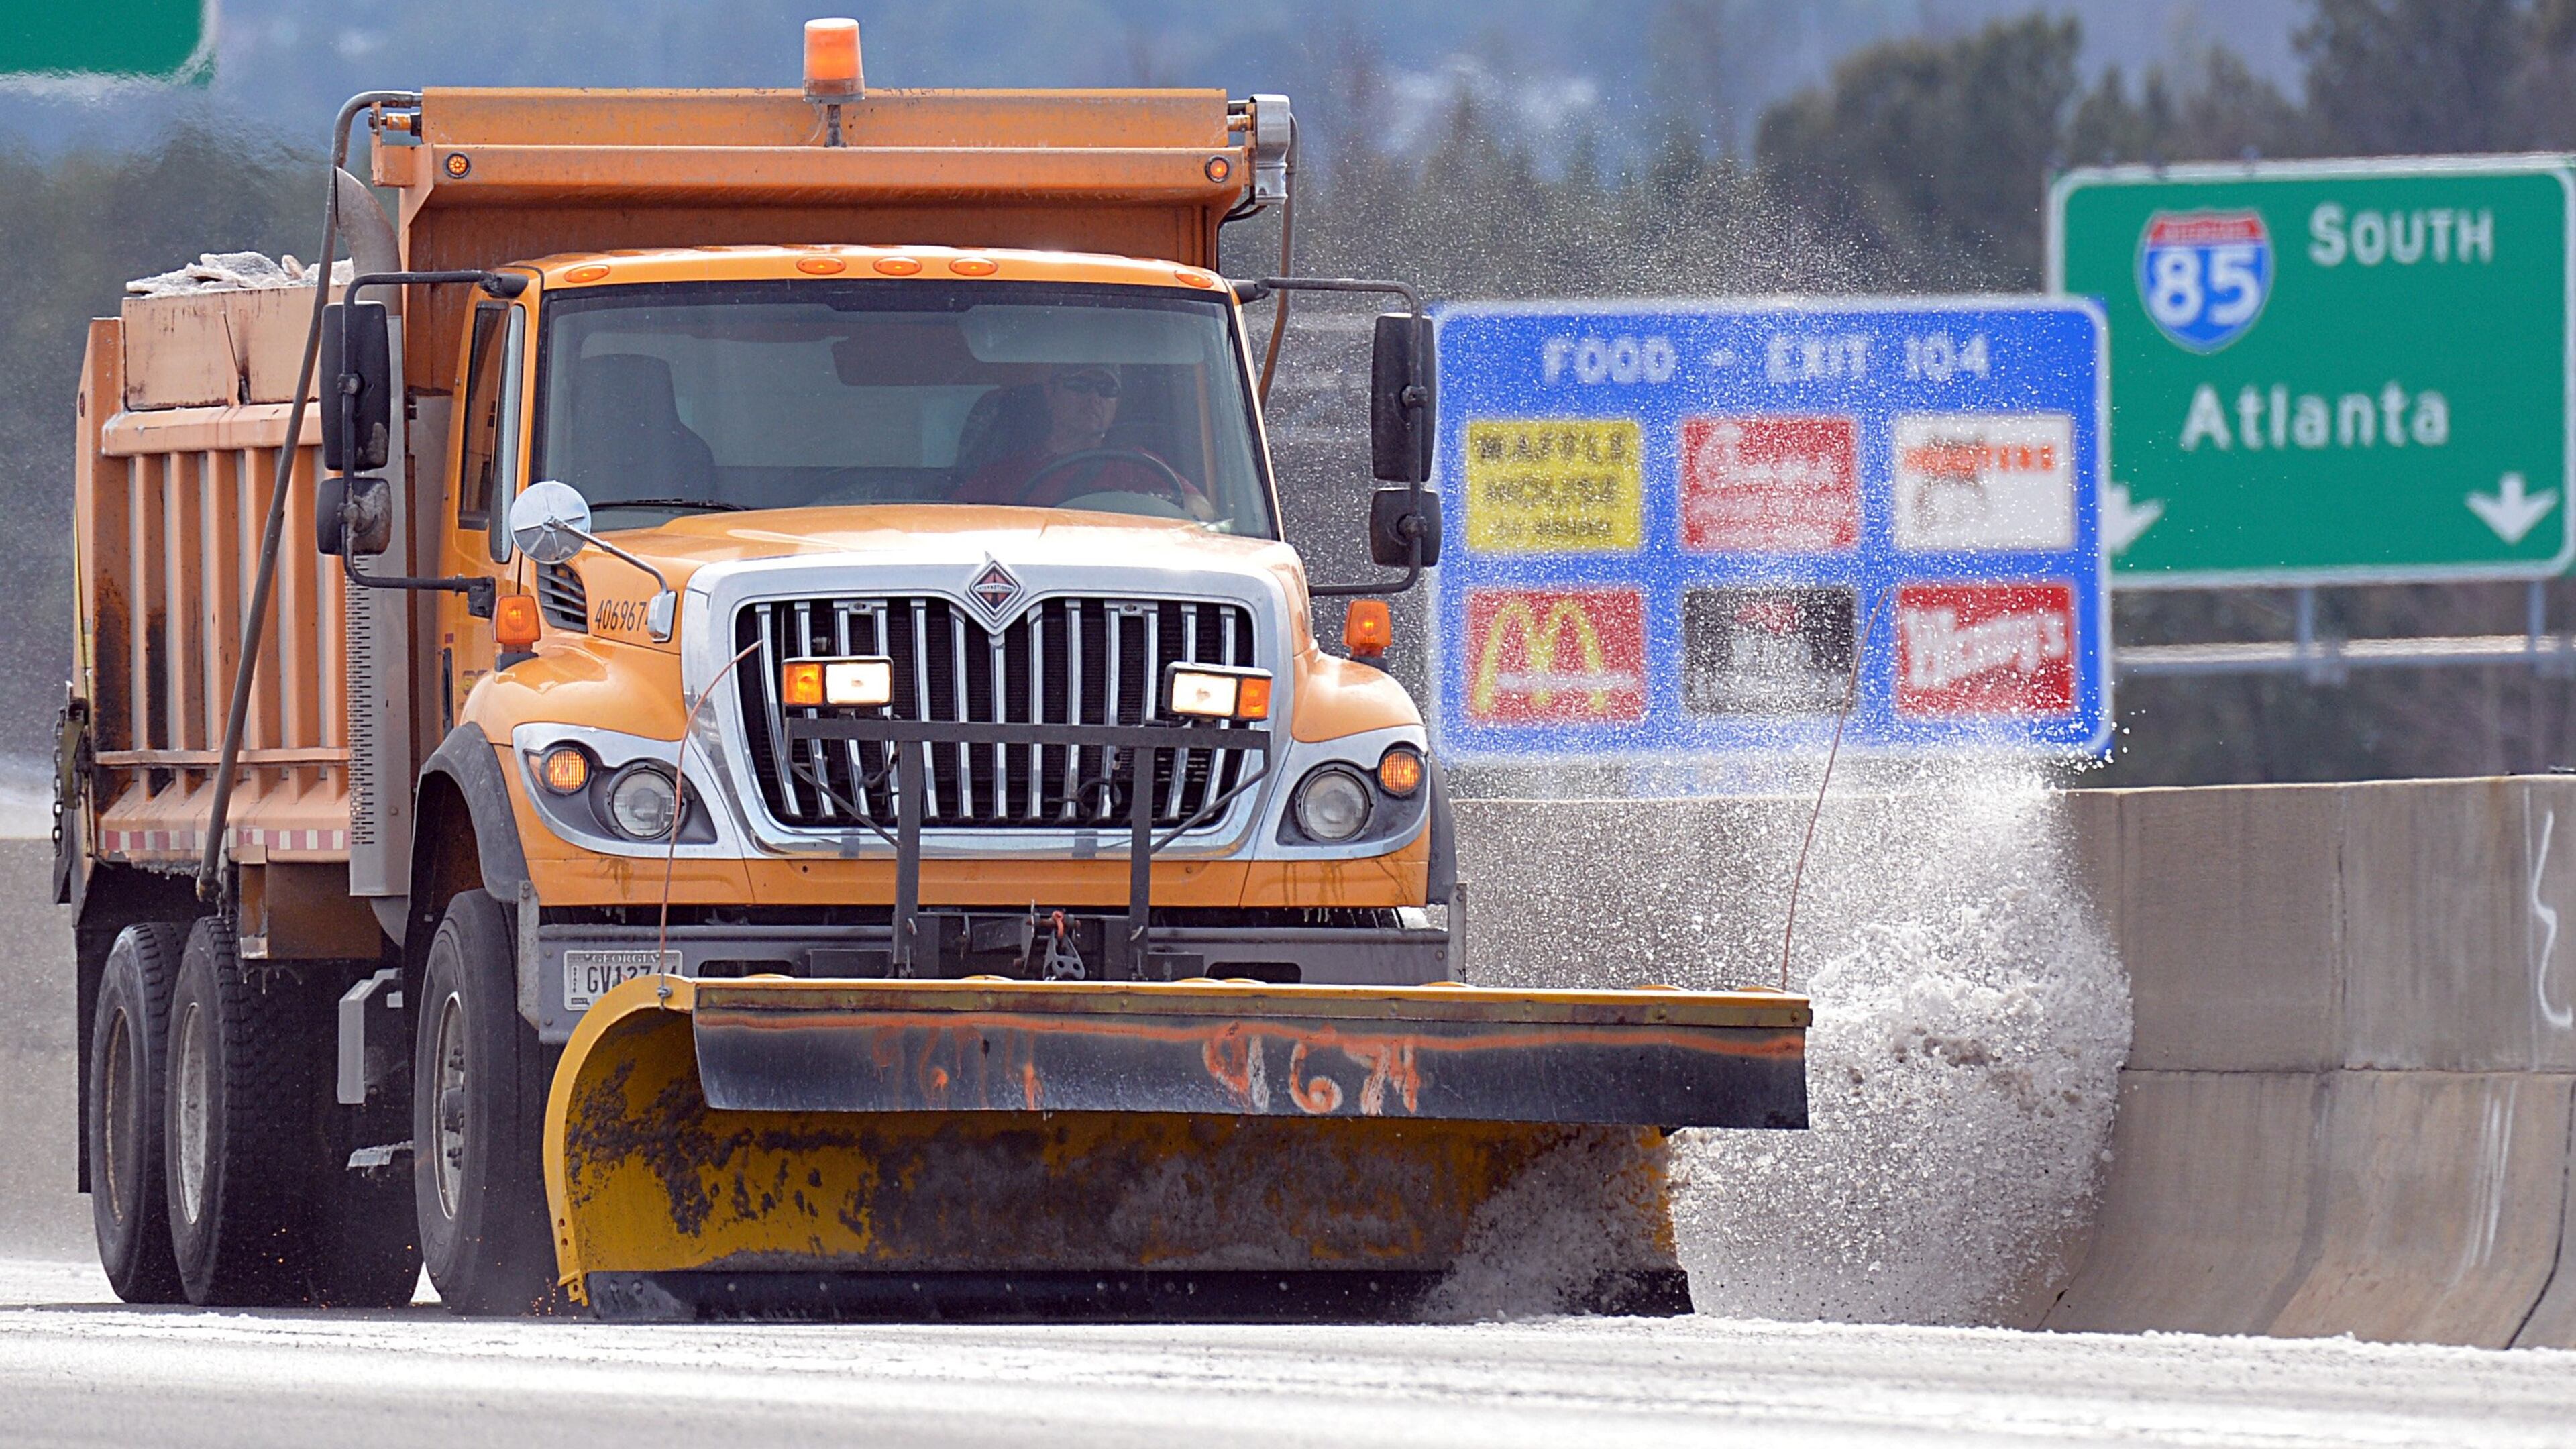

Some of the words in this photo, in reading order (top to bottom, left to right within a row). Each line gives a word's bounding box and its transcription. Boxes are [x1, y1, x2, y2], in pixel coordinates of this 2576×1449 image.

[2309, 203, 2494, 266] SOUTH
[2147, 250, 2261, 326] 85
[1544, 335, 1677, 386] FOOD
[1767, 335, 1866, 384] EXIT
[1907, 334, 1991, 382] 104
[2180, 382, 2449, 451] Atlanta
[594, 599, 649, 631] 406967
[592, 954, 656, 963] GEORGIA
